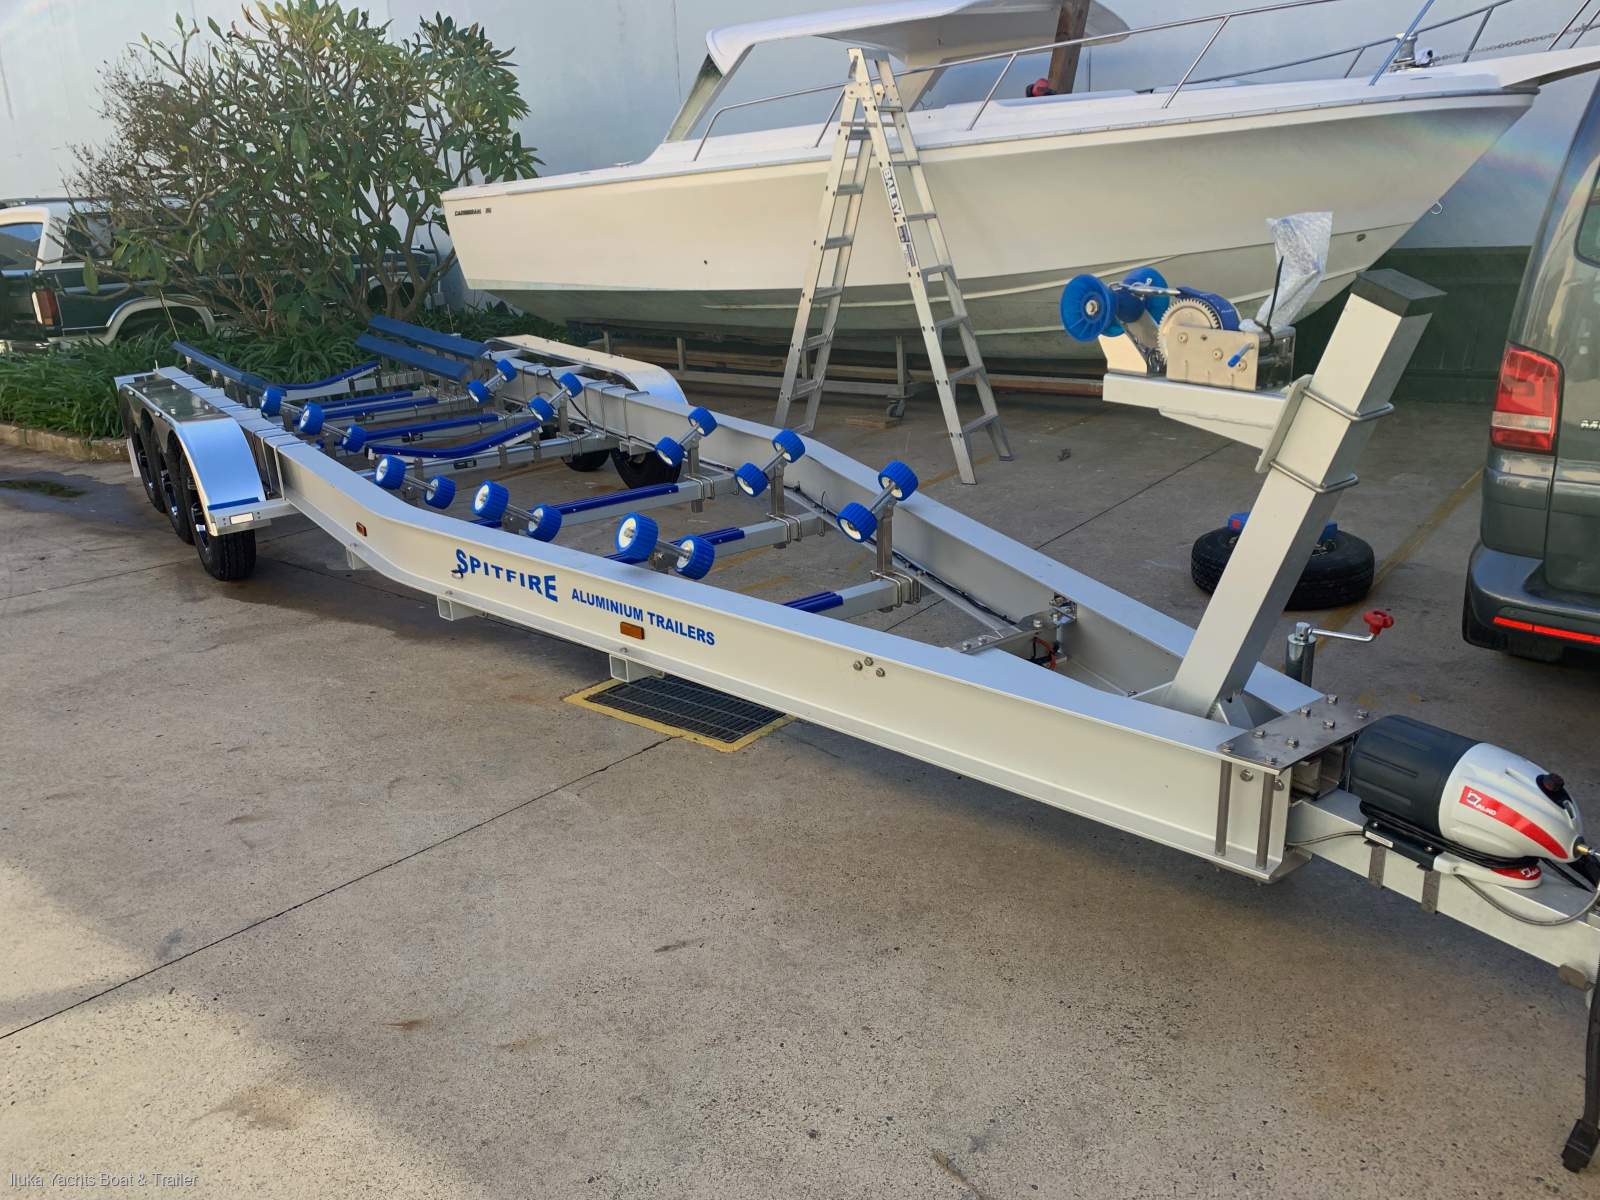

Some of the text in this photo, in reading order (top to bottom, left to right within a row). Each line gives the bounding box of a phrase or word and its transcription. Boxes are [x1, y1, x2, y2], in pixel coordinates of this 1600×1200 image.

[883, 167, 901, 216] BAILEY
[455, 549, 716, 646] SPITFIRE ALUMINIUM TRAILERS
